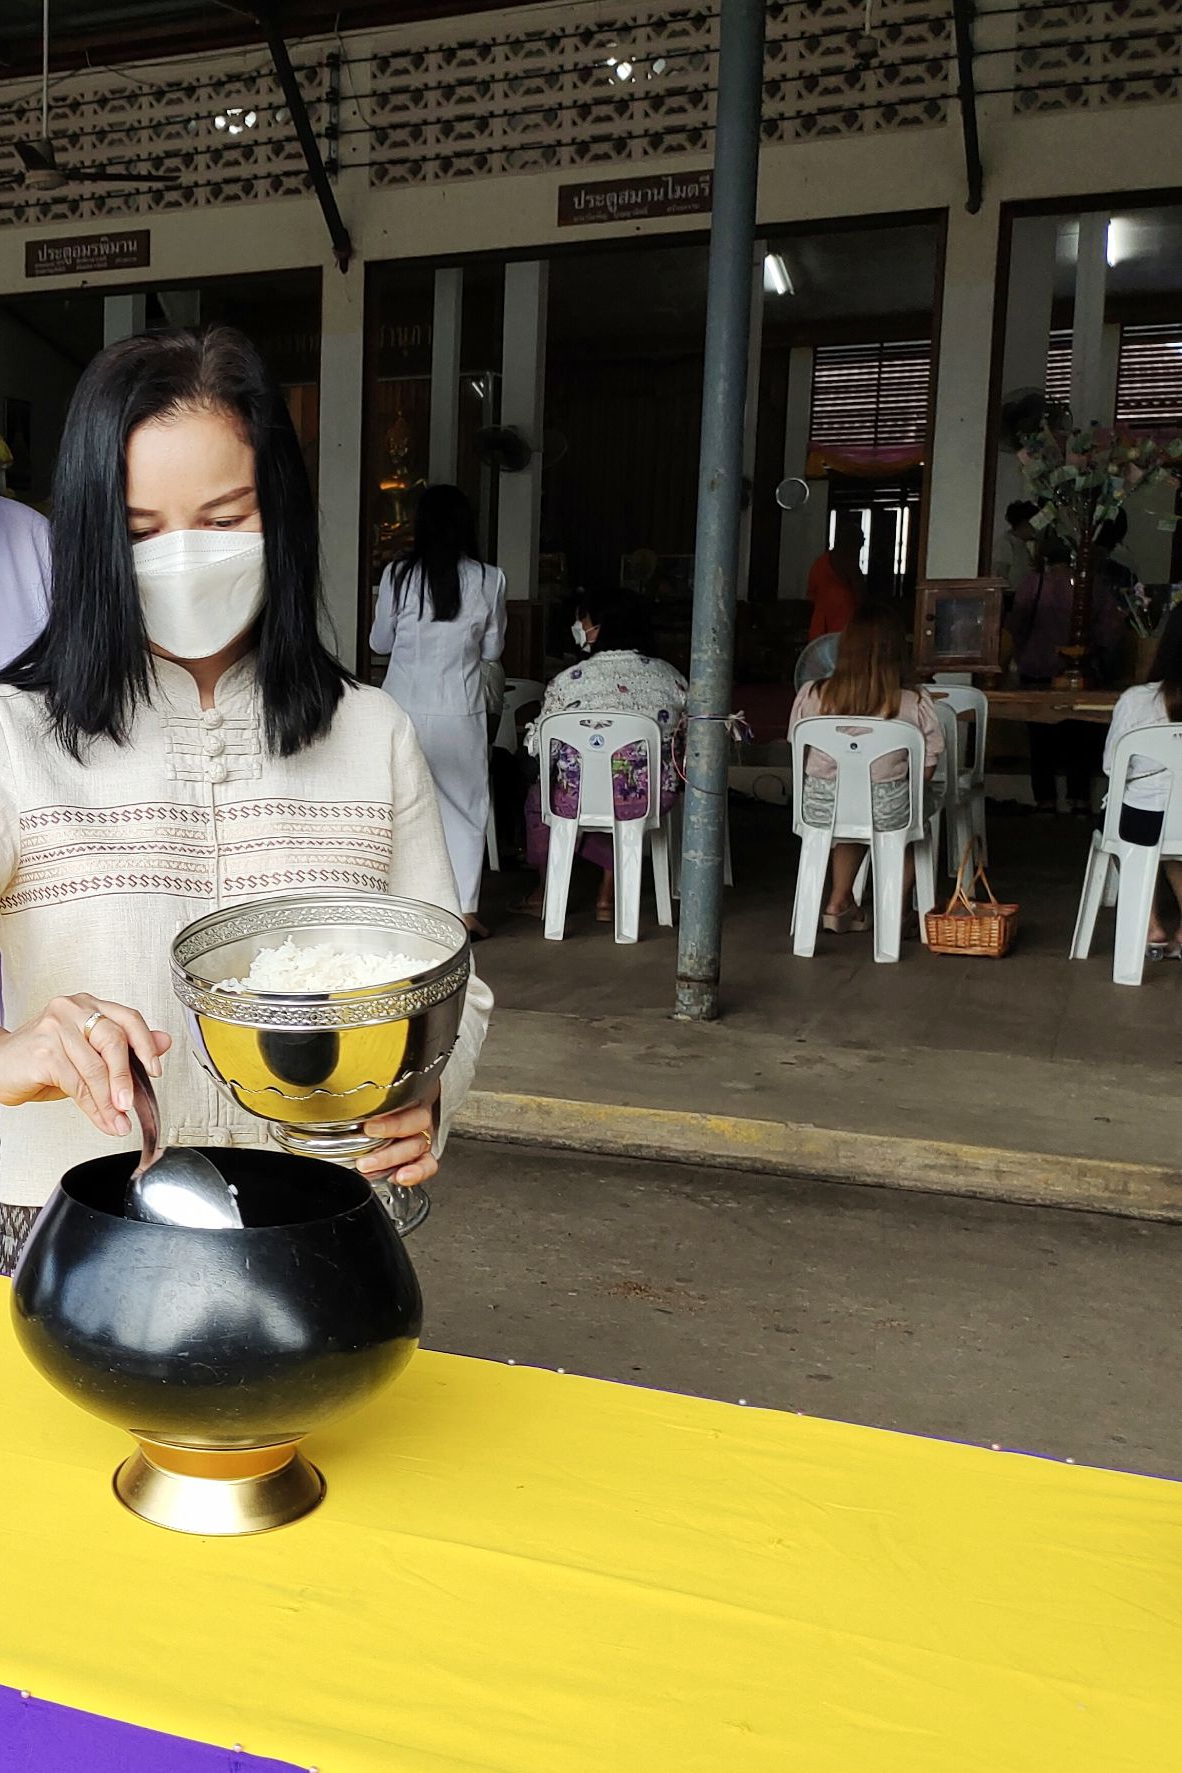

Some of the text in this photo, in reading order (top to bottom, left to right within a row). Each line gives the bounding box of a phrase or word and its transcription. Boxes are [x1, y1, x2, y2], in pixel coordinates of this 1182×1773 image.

[573, 175, 710, 213] ประตูสมานไมตรี
[38, 236, 137, 265] ประตูอมรพิมาน
